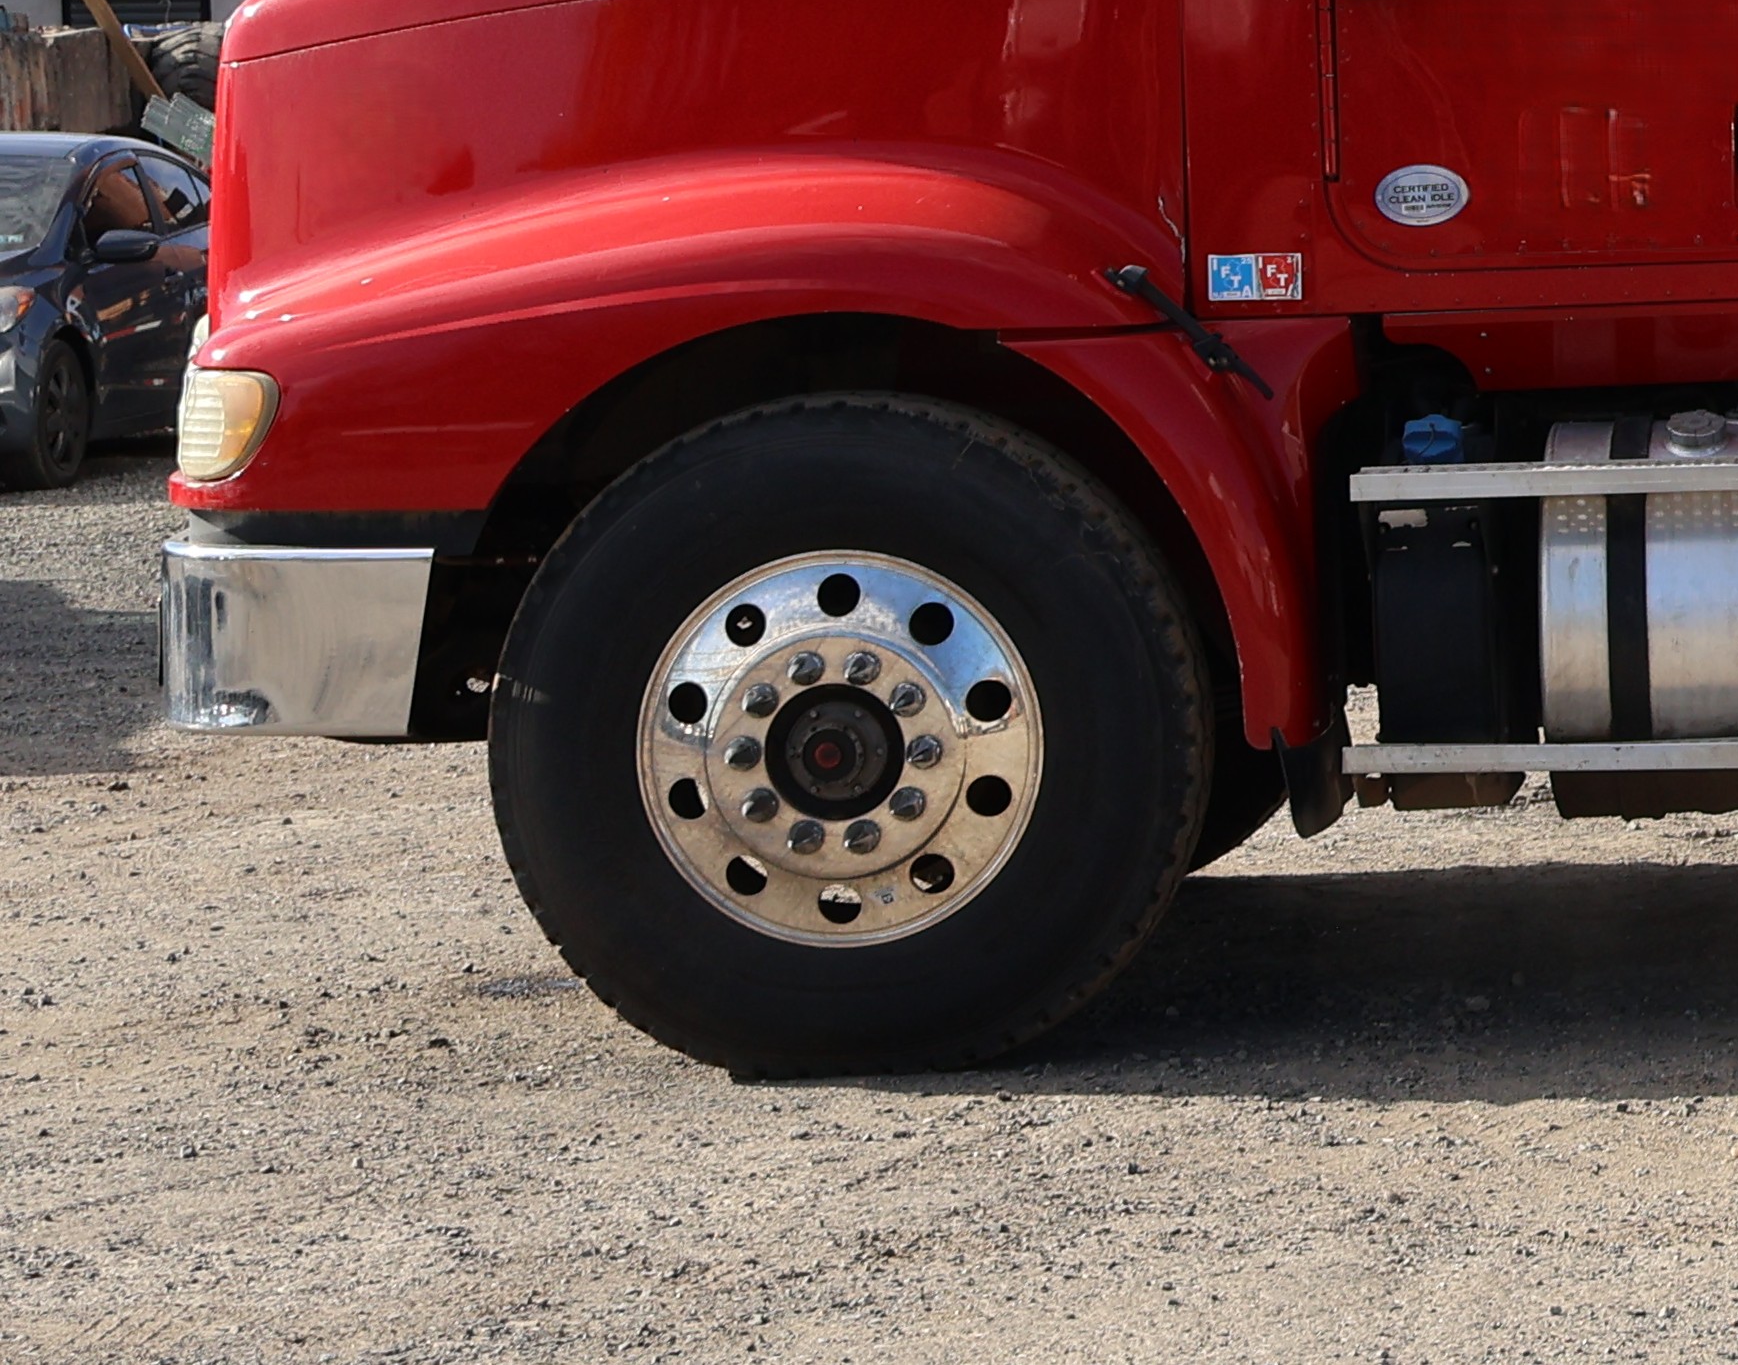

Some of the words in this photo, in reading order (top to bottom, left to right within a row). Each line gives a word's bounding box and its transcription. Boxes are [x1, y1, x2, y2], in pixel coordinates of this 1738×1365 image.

[1393, 183, 1449, 194] CERTIFIED
[1389, 194, 1426, 204] CLEAN
[1430, 193, 1455, 202] IDLE
